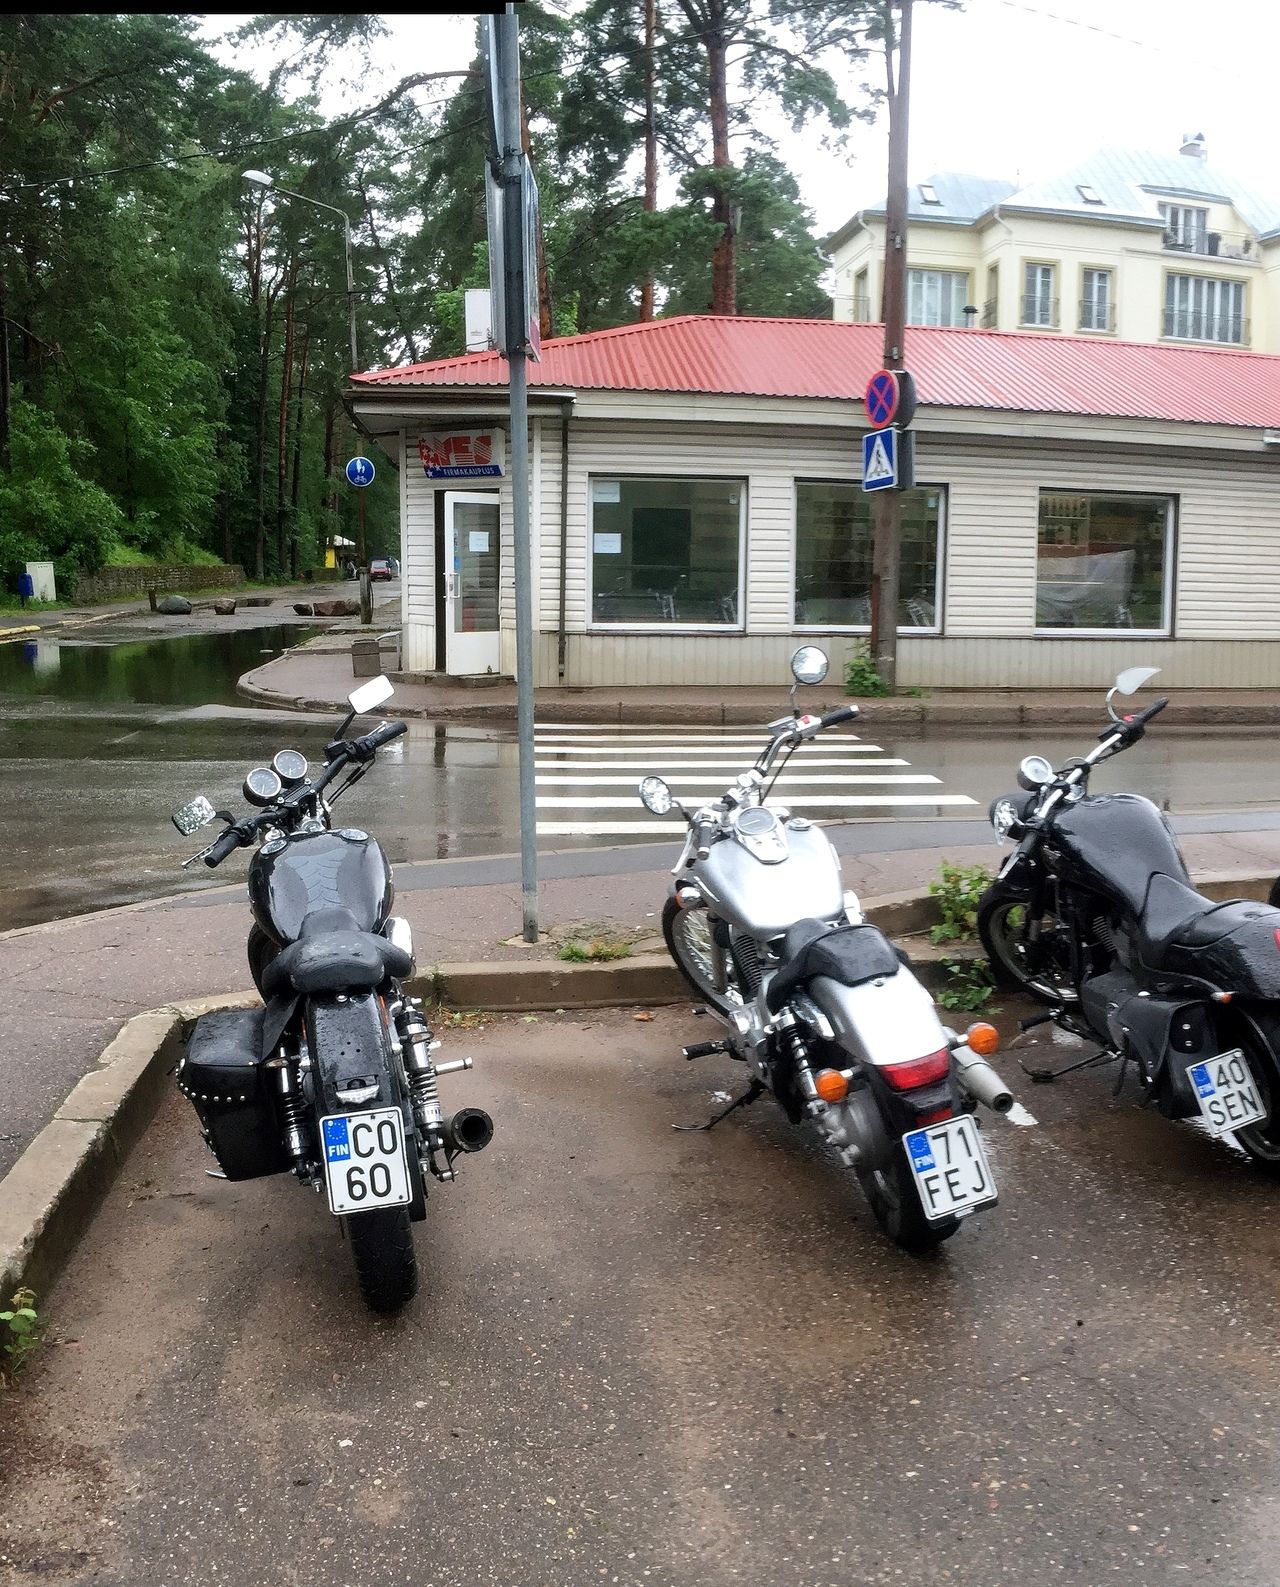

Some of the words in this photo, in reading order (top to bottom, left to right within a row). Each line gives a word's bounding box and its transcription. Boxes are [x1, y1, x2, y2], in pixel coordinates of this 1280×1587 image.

[443, 467, 495, 477] FIRMAKAUPLUS
[1217, 1058, 1246, 1089] 40
[1208, 1086, 1259, 1127] SEN
[328, 1143, 349, 1157] FIN
[932, 1126, 973, 1165] 71
[346, 1162, 392, 1202] 60
[923, 1160, 985, 1209] FEJ
